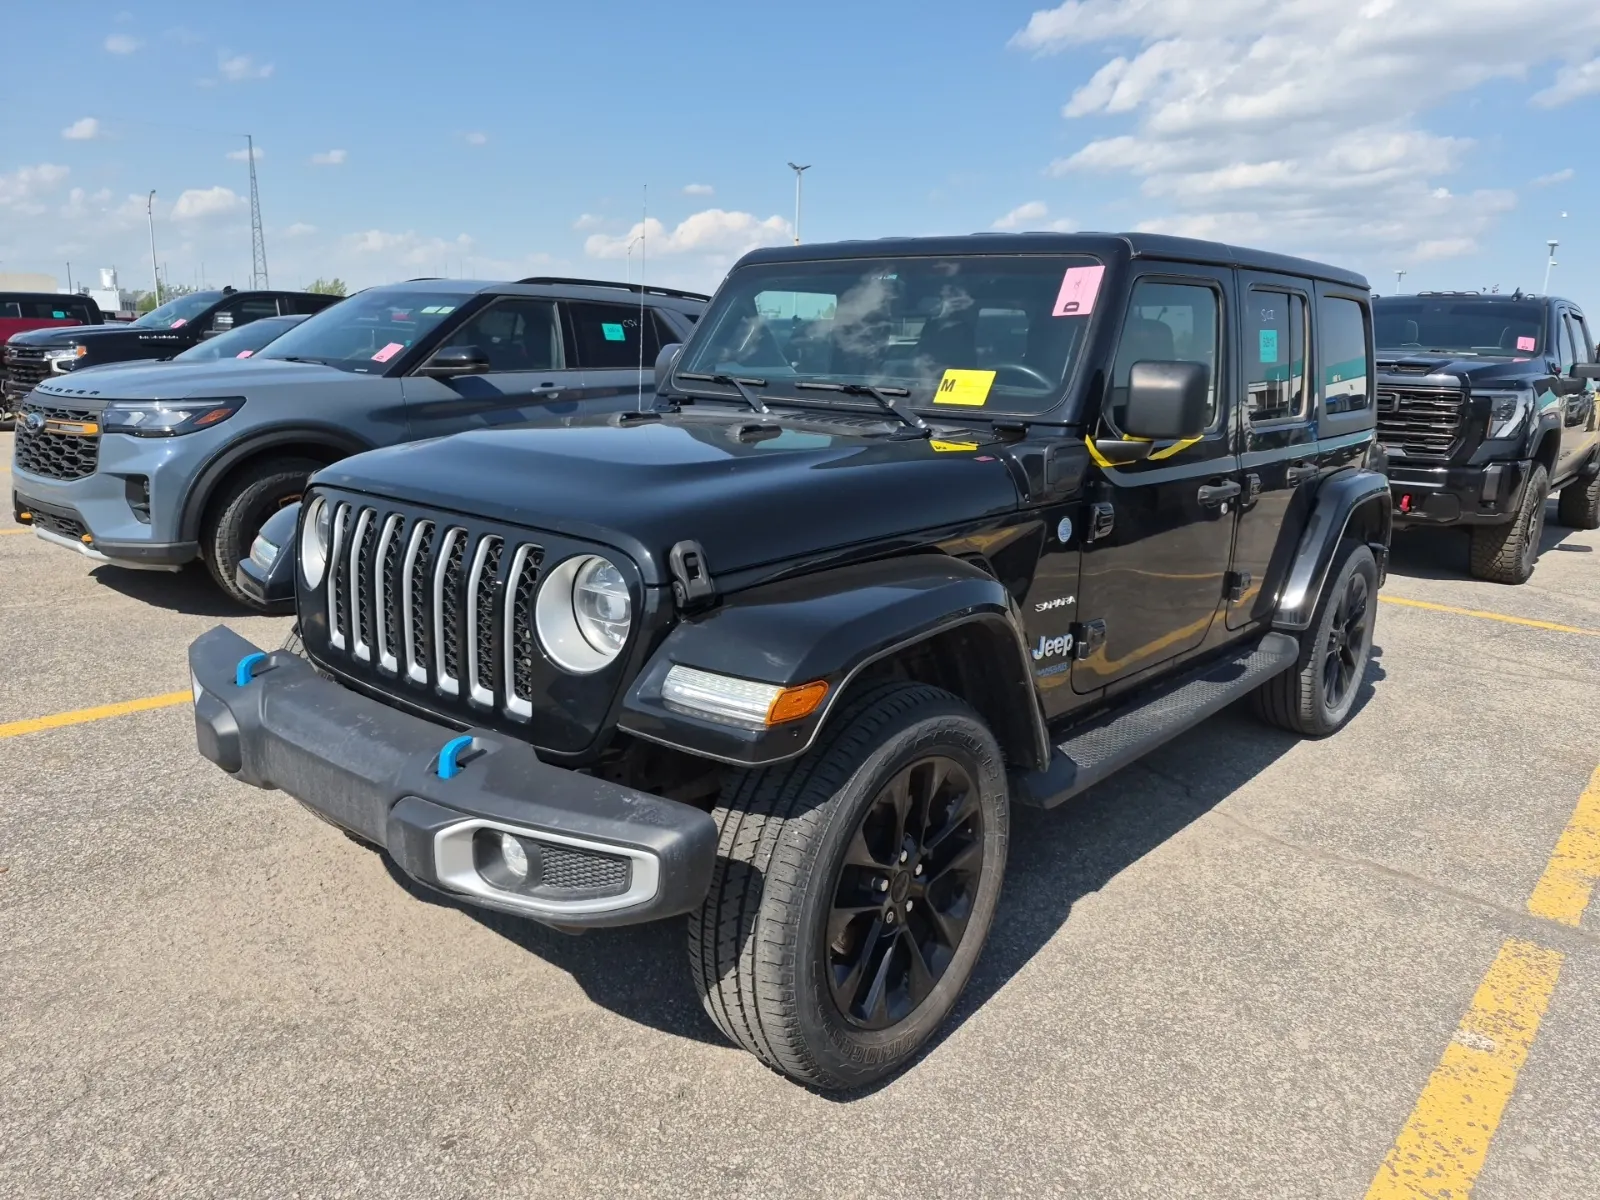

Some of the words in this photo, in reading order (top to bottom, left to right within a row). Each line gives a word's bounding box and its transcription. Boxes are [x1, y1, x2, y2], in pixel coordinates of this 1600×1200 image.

[1063, 301, 1080, 312] D
[38, 384, 100, 395] XPLORER
[940, 378, 957, 393] M
[1034, 595, 1076, 613] SAHARA
[1031, 633, 1074, 660] Jeep
